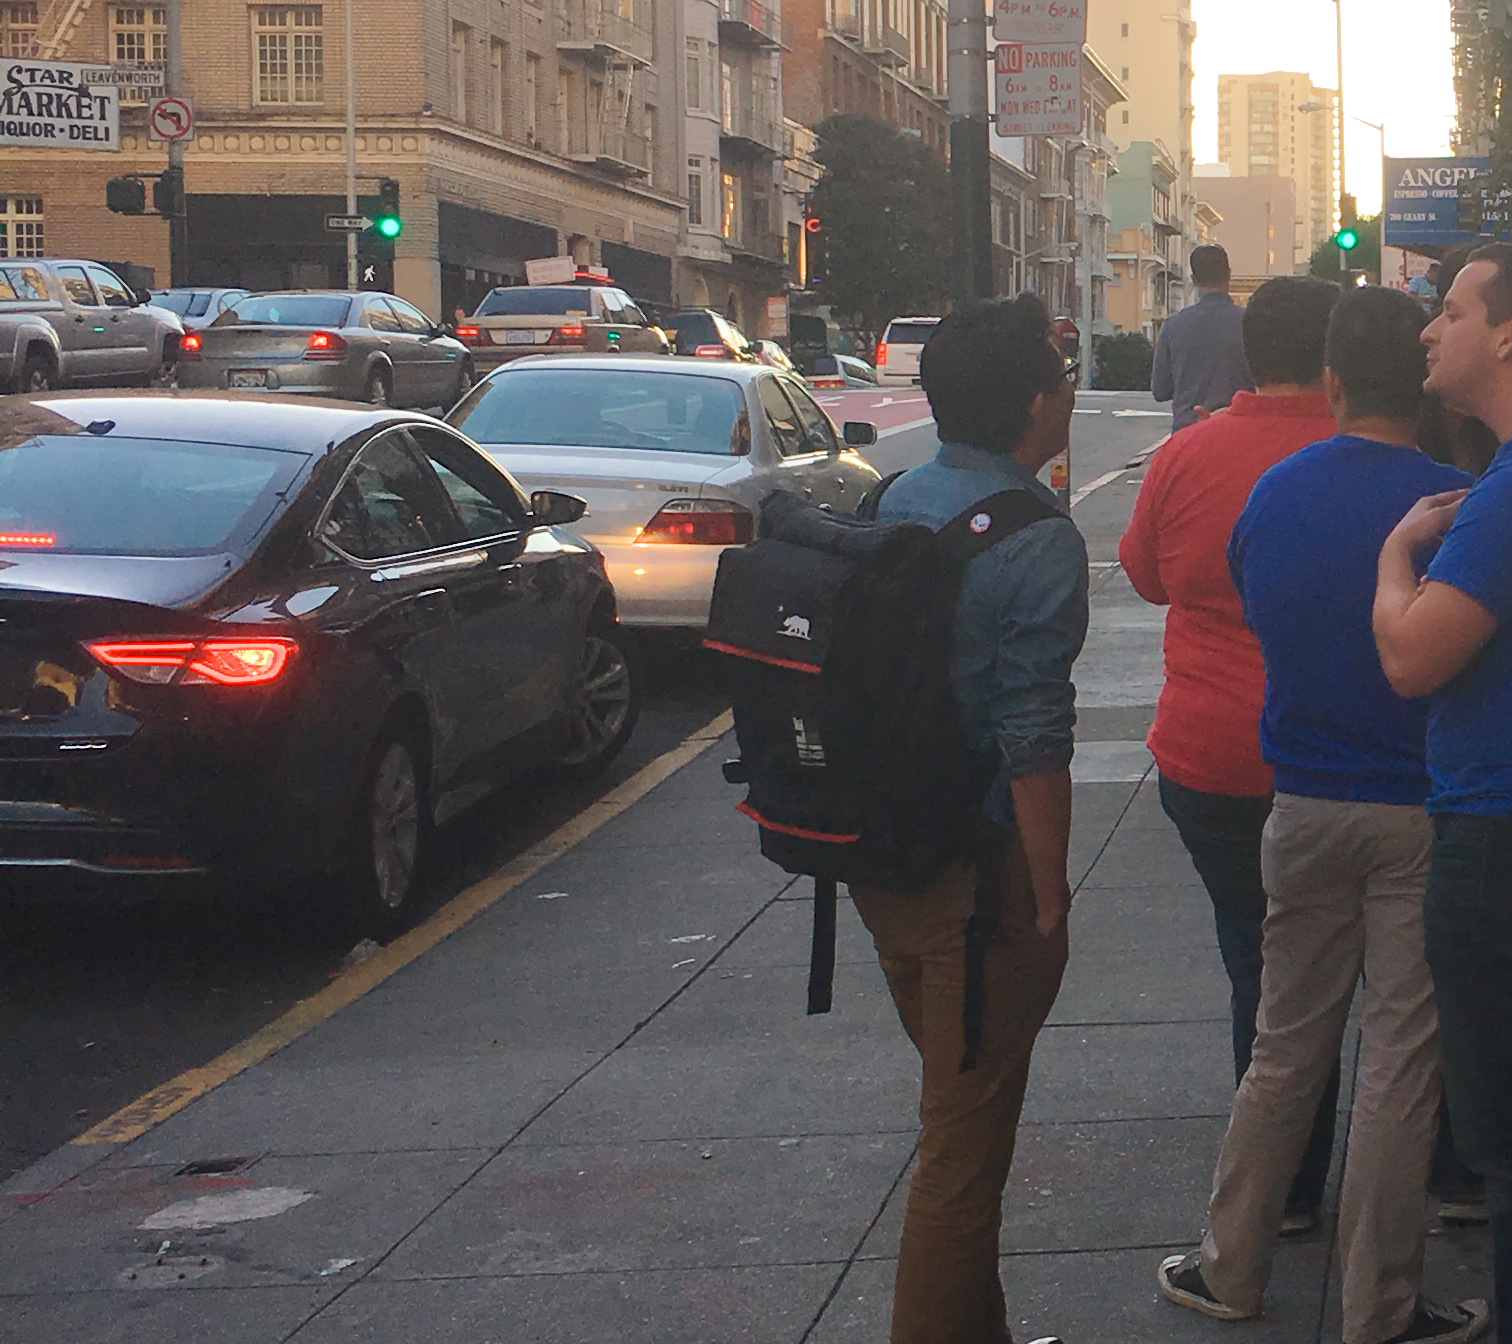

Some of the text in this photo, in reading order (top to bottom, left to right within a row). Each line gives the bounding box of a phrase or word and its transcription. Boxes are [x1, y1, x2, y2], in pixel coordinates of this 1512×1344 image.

[998, 47, 1077, 71] NO PARKING
[3, 65, 73, 93] STAR
[85, 70, 160, 84] LEAVENWORTH
[1000, 101, 1019, 116] MON
[1022, 100, 1040, 115] WED
[68, 124, 110, 142] DELI
